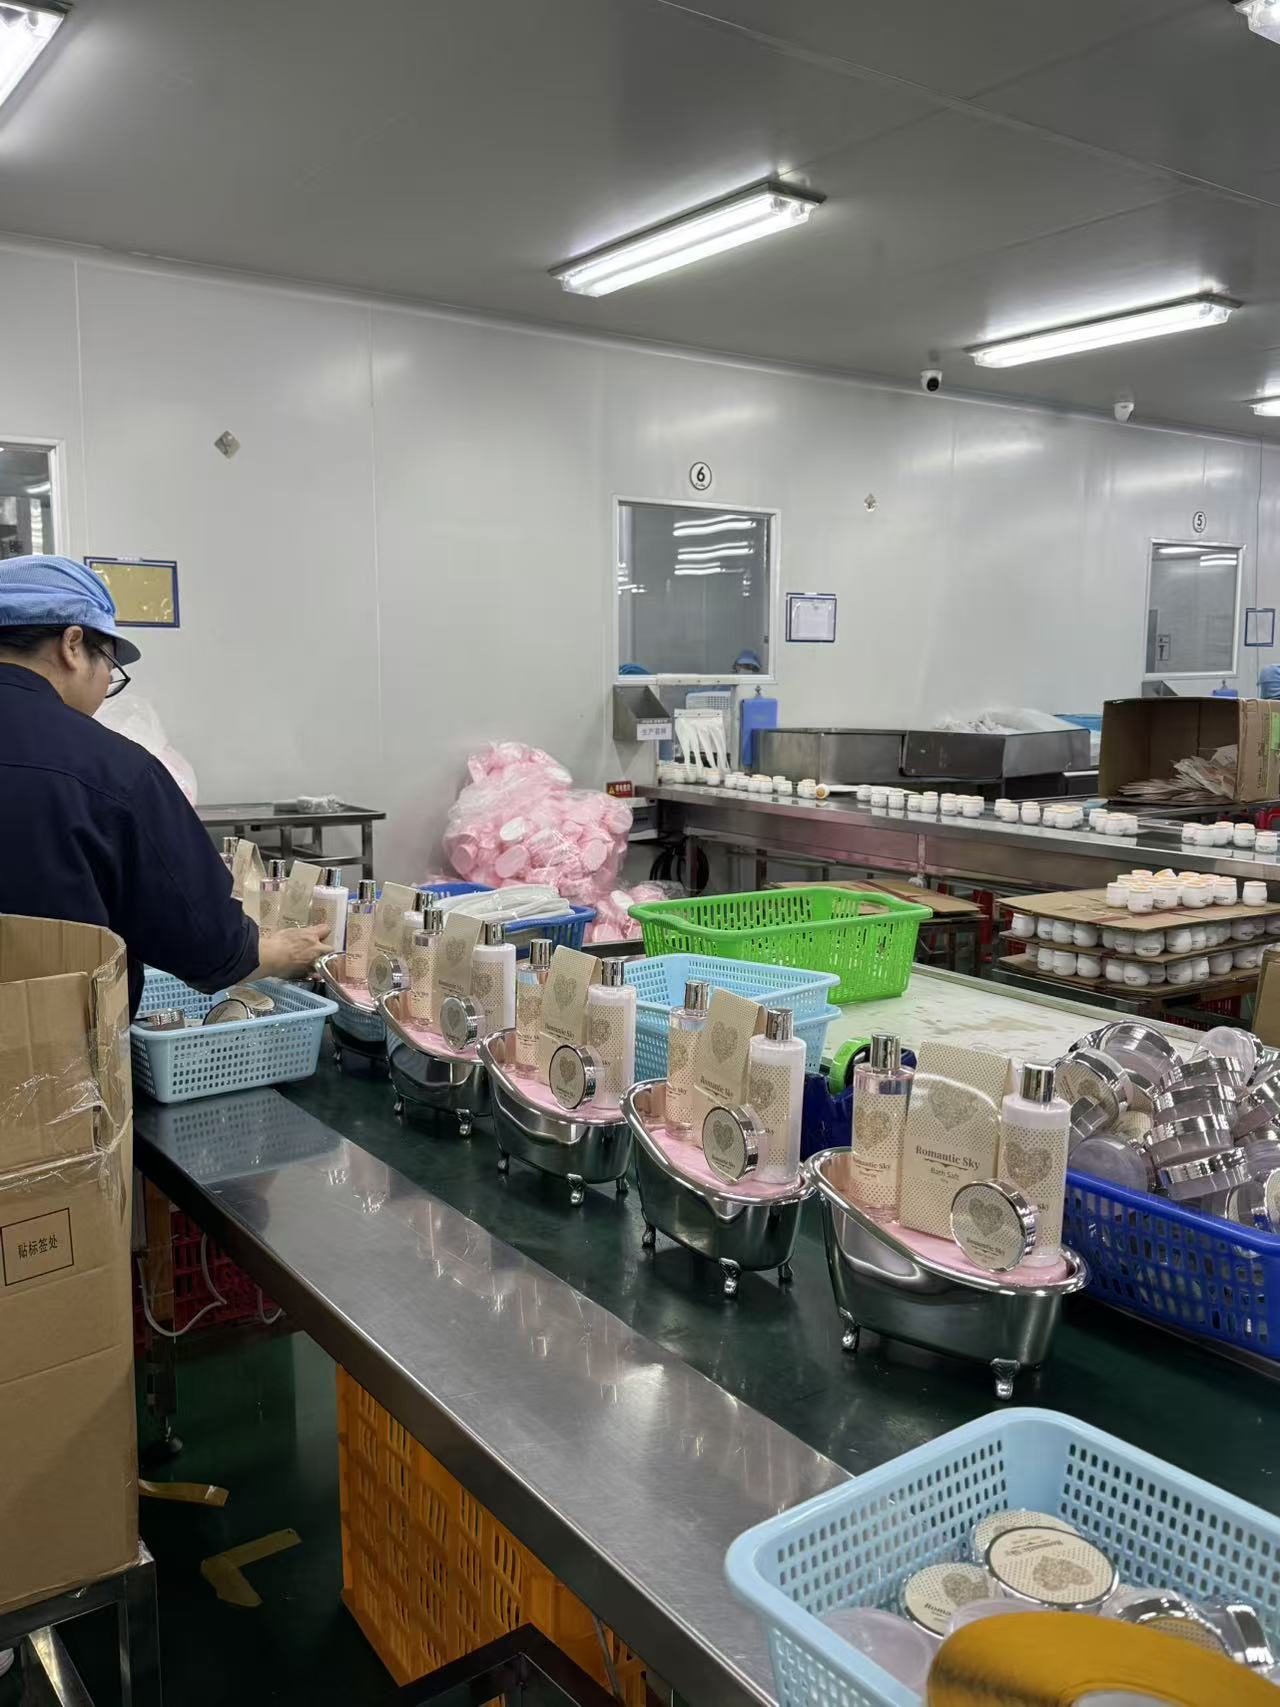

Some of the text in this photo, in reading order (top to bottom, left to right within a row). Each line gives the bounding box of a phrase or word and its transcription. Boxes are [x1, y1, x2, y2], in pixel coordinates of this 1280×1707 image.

[697, 466, 705, 482] 6
[1196, 514, 1203, 527] 5
[916, 1145, 981, 1171] Romantic Sky
[18, 1234, 58, 1260] 贴标签处
[924, 1602, 951, 1616] Roma
